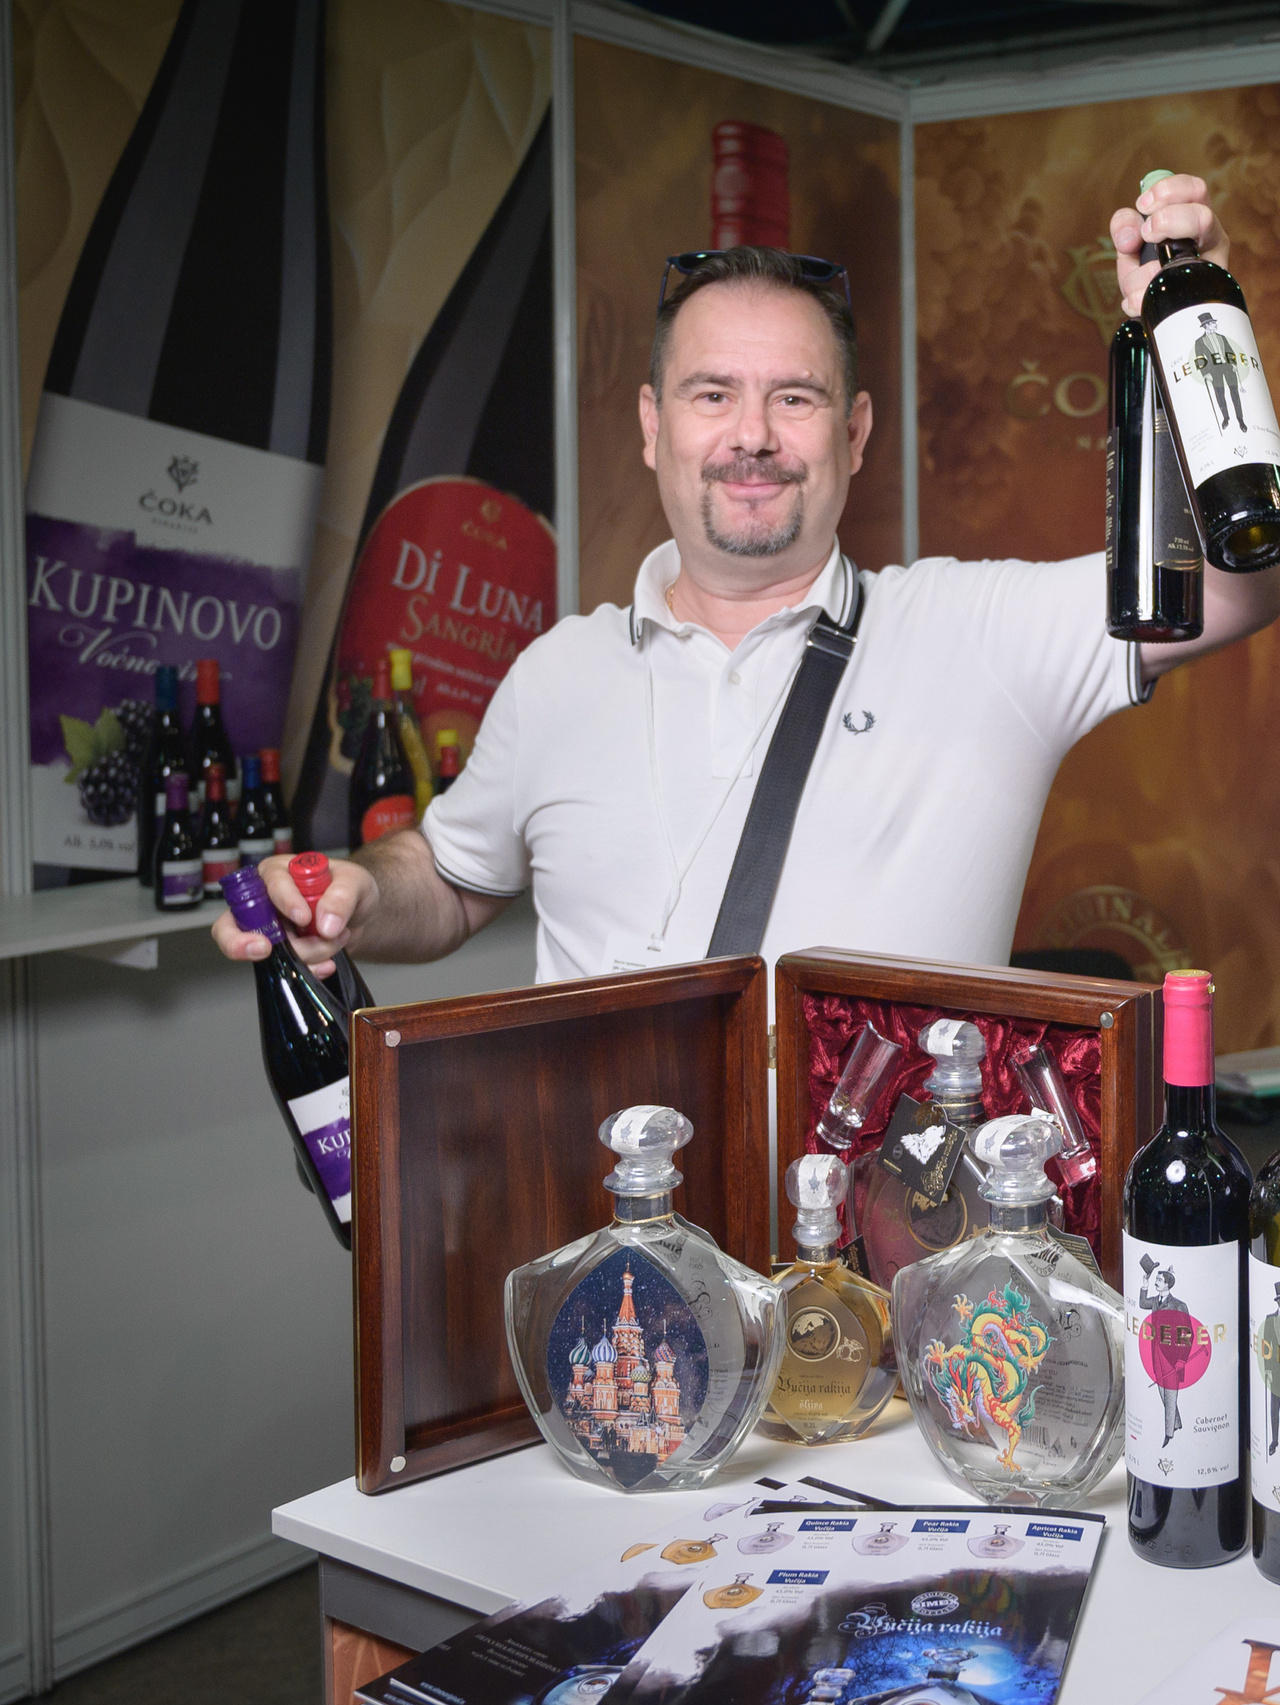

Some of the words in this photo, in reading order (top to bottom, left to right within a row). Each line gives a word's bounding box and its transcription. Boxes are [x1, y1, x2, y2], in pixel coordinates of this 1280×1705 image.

[1173, 352, 1260, 383] LEDERER
[1004, 360, 1109, 419] ČO
[138, 489, 213, 525] ČOKA
[29, 556, 282, 650] KUPINOVO
[450, 564, 543, 633] LUNA
[1126, 1311, 1228, 1346] LEDERER
[1193, 1421, 1230, 1433] Sauvignon
[1195, 1413, 1228, 1425] Cabernet
[1032, 1525, 1057, 1533] Apricot
[938, 1620, 1003, 1638] rakija
